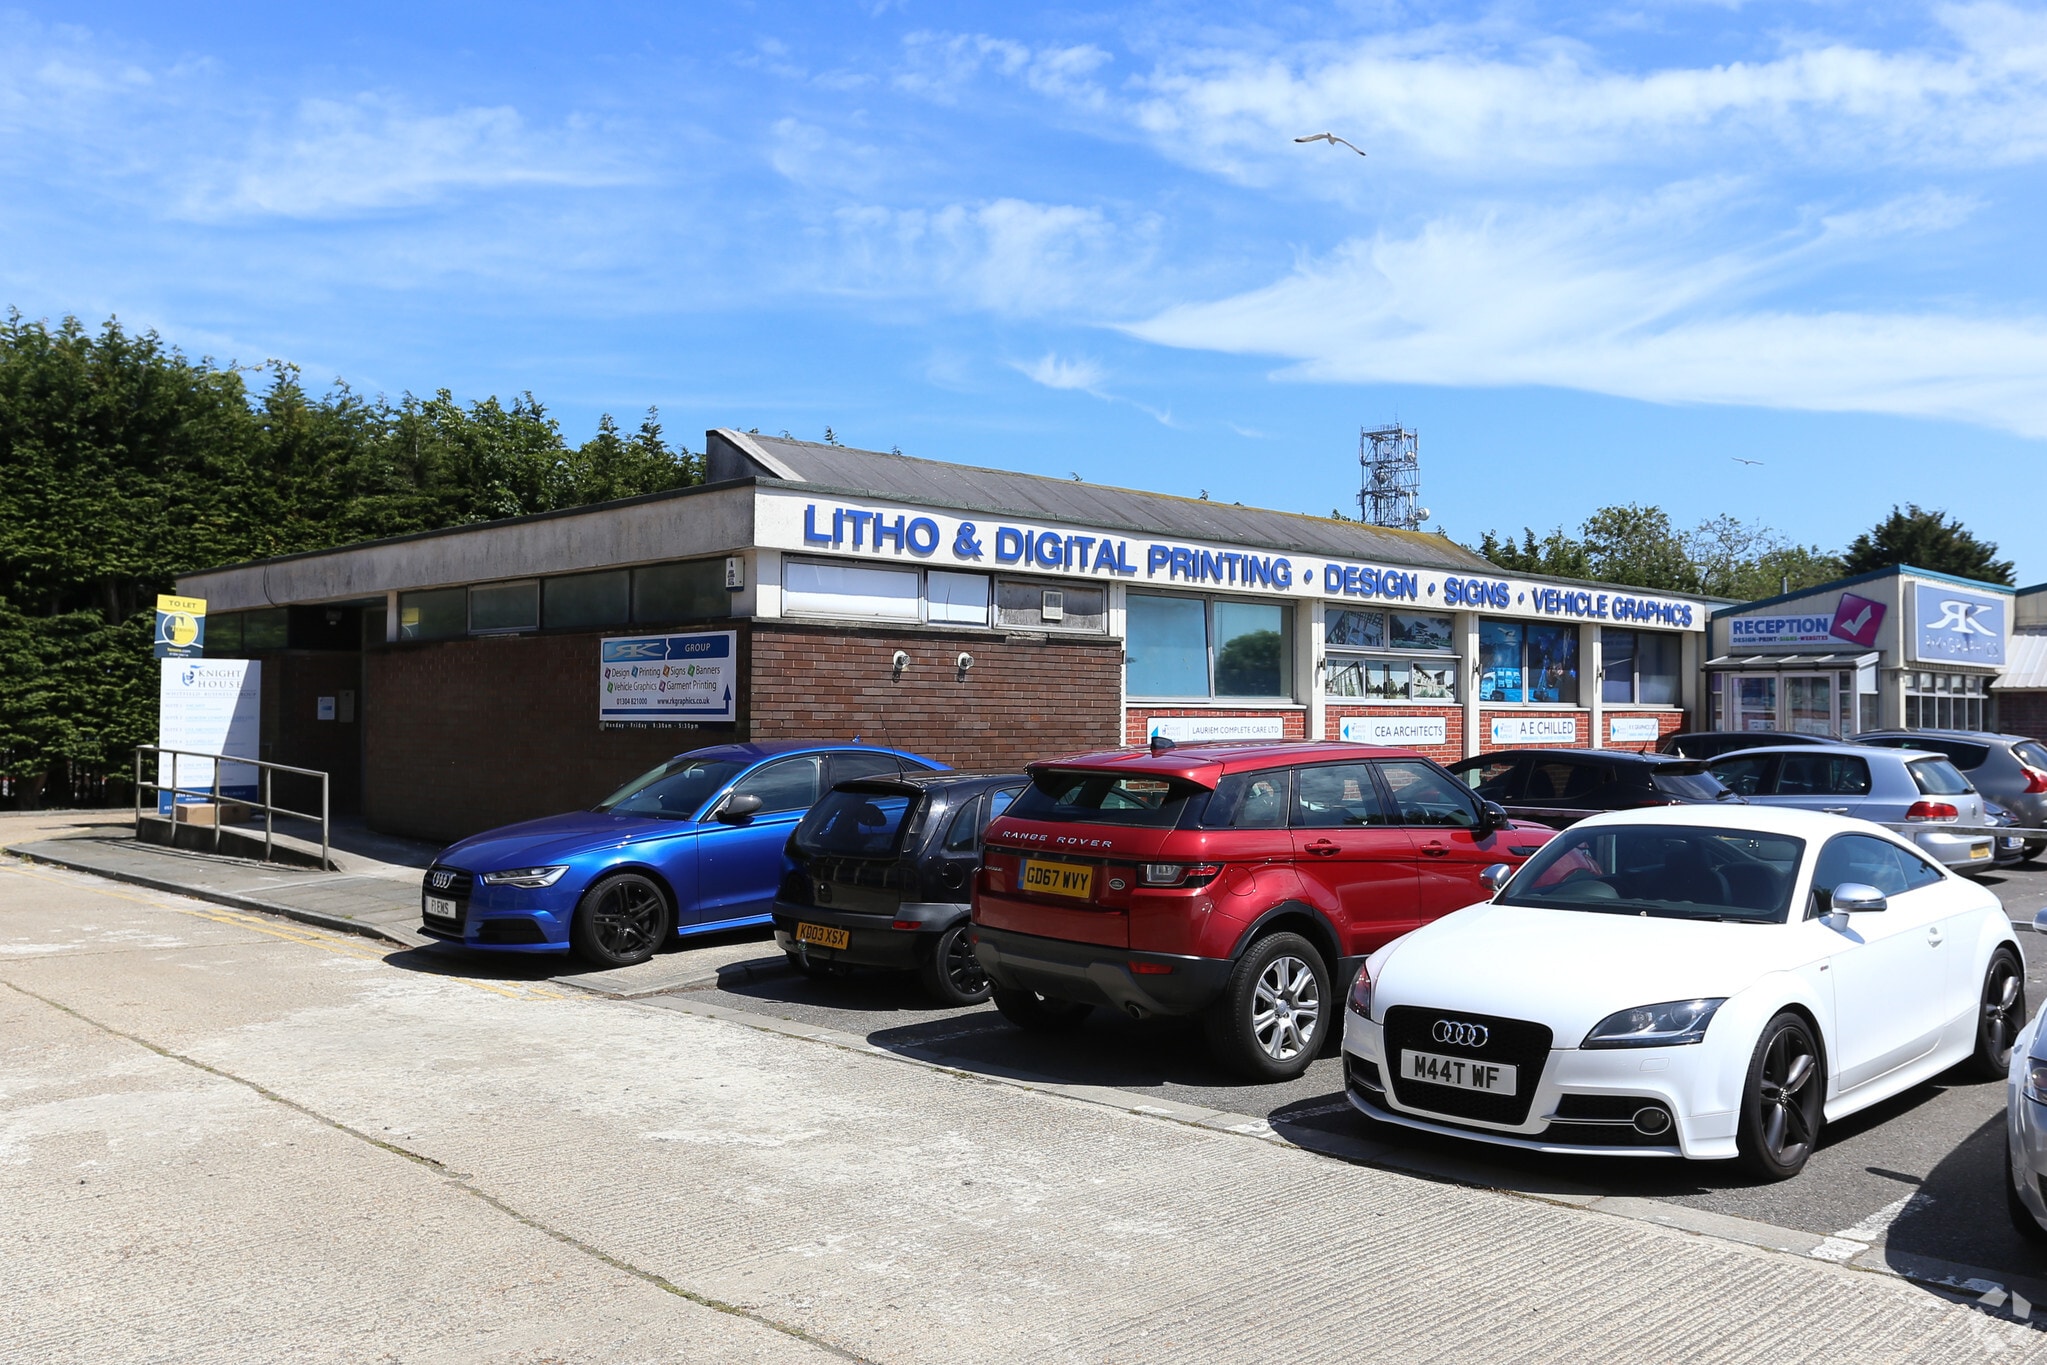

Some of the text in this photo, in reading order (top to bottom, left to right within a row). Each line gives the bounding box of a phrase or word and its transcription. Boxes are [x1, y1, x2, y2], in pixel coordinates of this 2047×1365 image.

[804, 504, 1692, 626] LITHO & DIGITAL PRINTING DESIGN SIGNS VEHICLE GRAPHICS
[1733, 618, 1828, 635] RECEPTION
[684, 643, 711, 652] GROUP
[198, 669, 242, 678] KNIGHT
[611, 665, 721, 679] Design Printing Signs Banners
[198, 680, 242, 688] HOUSE
[613, 679, 717, 692] Vehicle Graphics Garment Printing
[657, 696, 710, 707] www.rkgraphics.co.uk
[1192, 725, 1279, 735] LAURIEM COMPLETE CARE LTD
[1375, 725, 1392, 737] CEA
[1393, 725, 1443, 737] ARCHITECTS
[1519, 721, 1527, 735] A
[1529, 721, 1535, 735] E
[1537, 721, 1574, 735] CHILLED
[1002, 830, 1113, 848] RANGE ROVER
[1026, 866, 1089, 891] GD67 WVY
[437, 900, 449, 915] EMS
[825, 928, 846, 945] XSX
[1414, 1055, 1501, 1089] M44T WF
